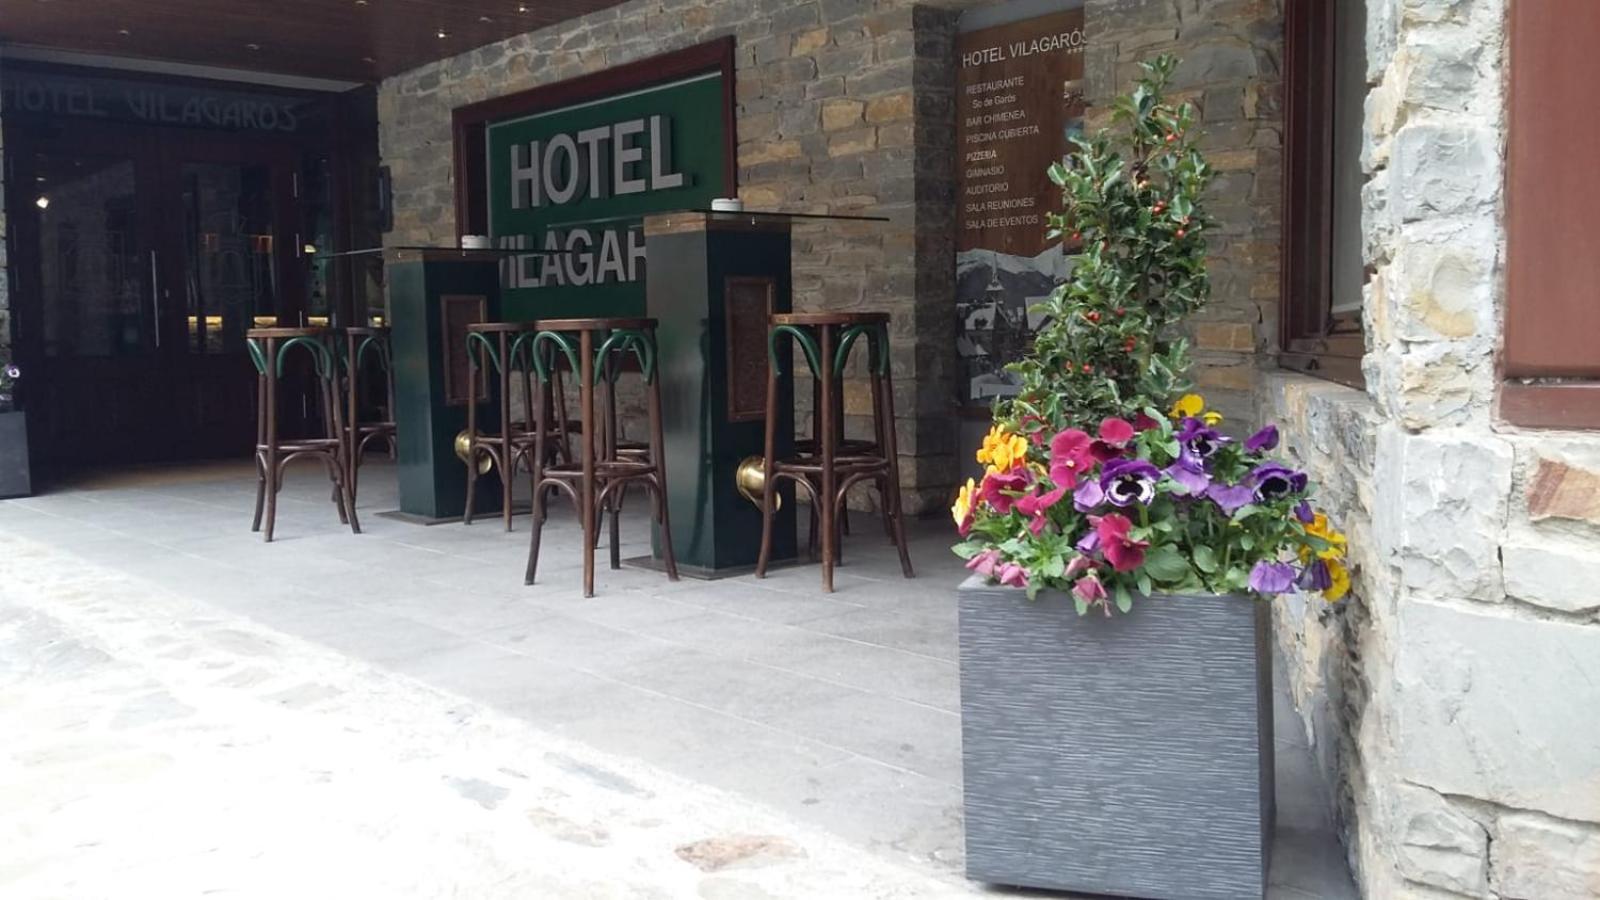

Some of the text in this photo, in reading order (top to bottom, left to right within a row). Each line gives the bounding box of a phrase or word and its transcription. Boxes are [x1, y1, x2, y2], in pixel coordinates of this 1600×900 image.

[962, 47, 1006, 68] HOTEL
[966, 76, 1025, 94] RESTAURANTE
[966, 110, 1026, 127] BAR CHIMENEA
[966, 125, 1040, 144] PISCINA CUBIERTA
[510, 115, 685, 209] HOTEL
[966, 149, 997, 162] PIZZERIA
[966, 165, 1005, 178] GIMNASIO
[966, 182, 1009, 195] AUDITORIO
[966, 197, 1035, 213] SALA REUNIONES
[966, 214, 1039, 230] SALA DE EVENTOS
